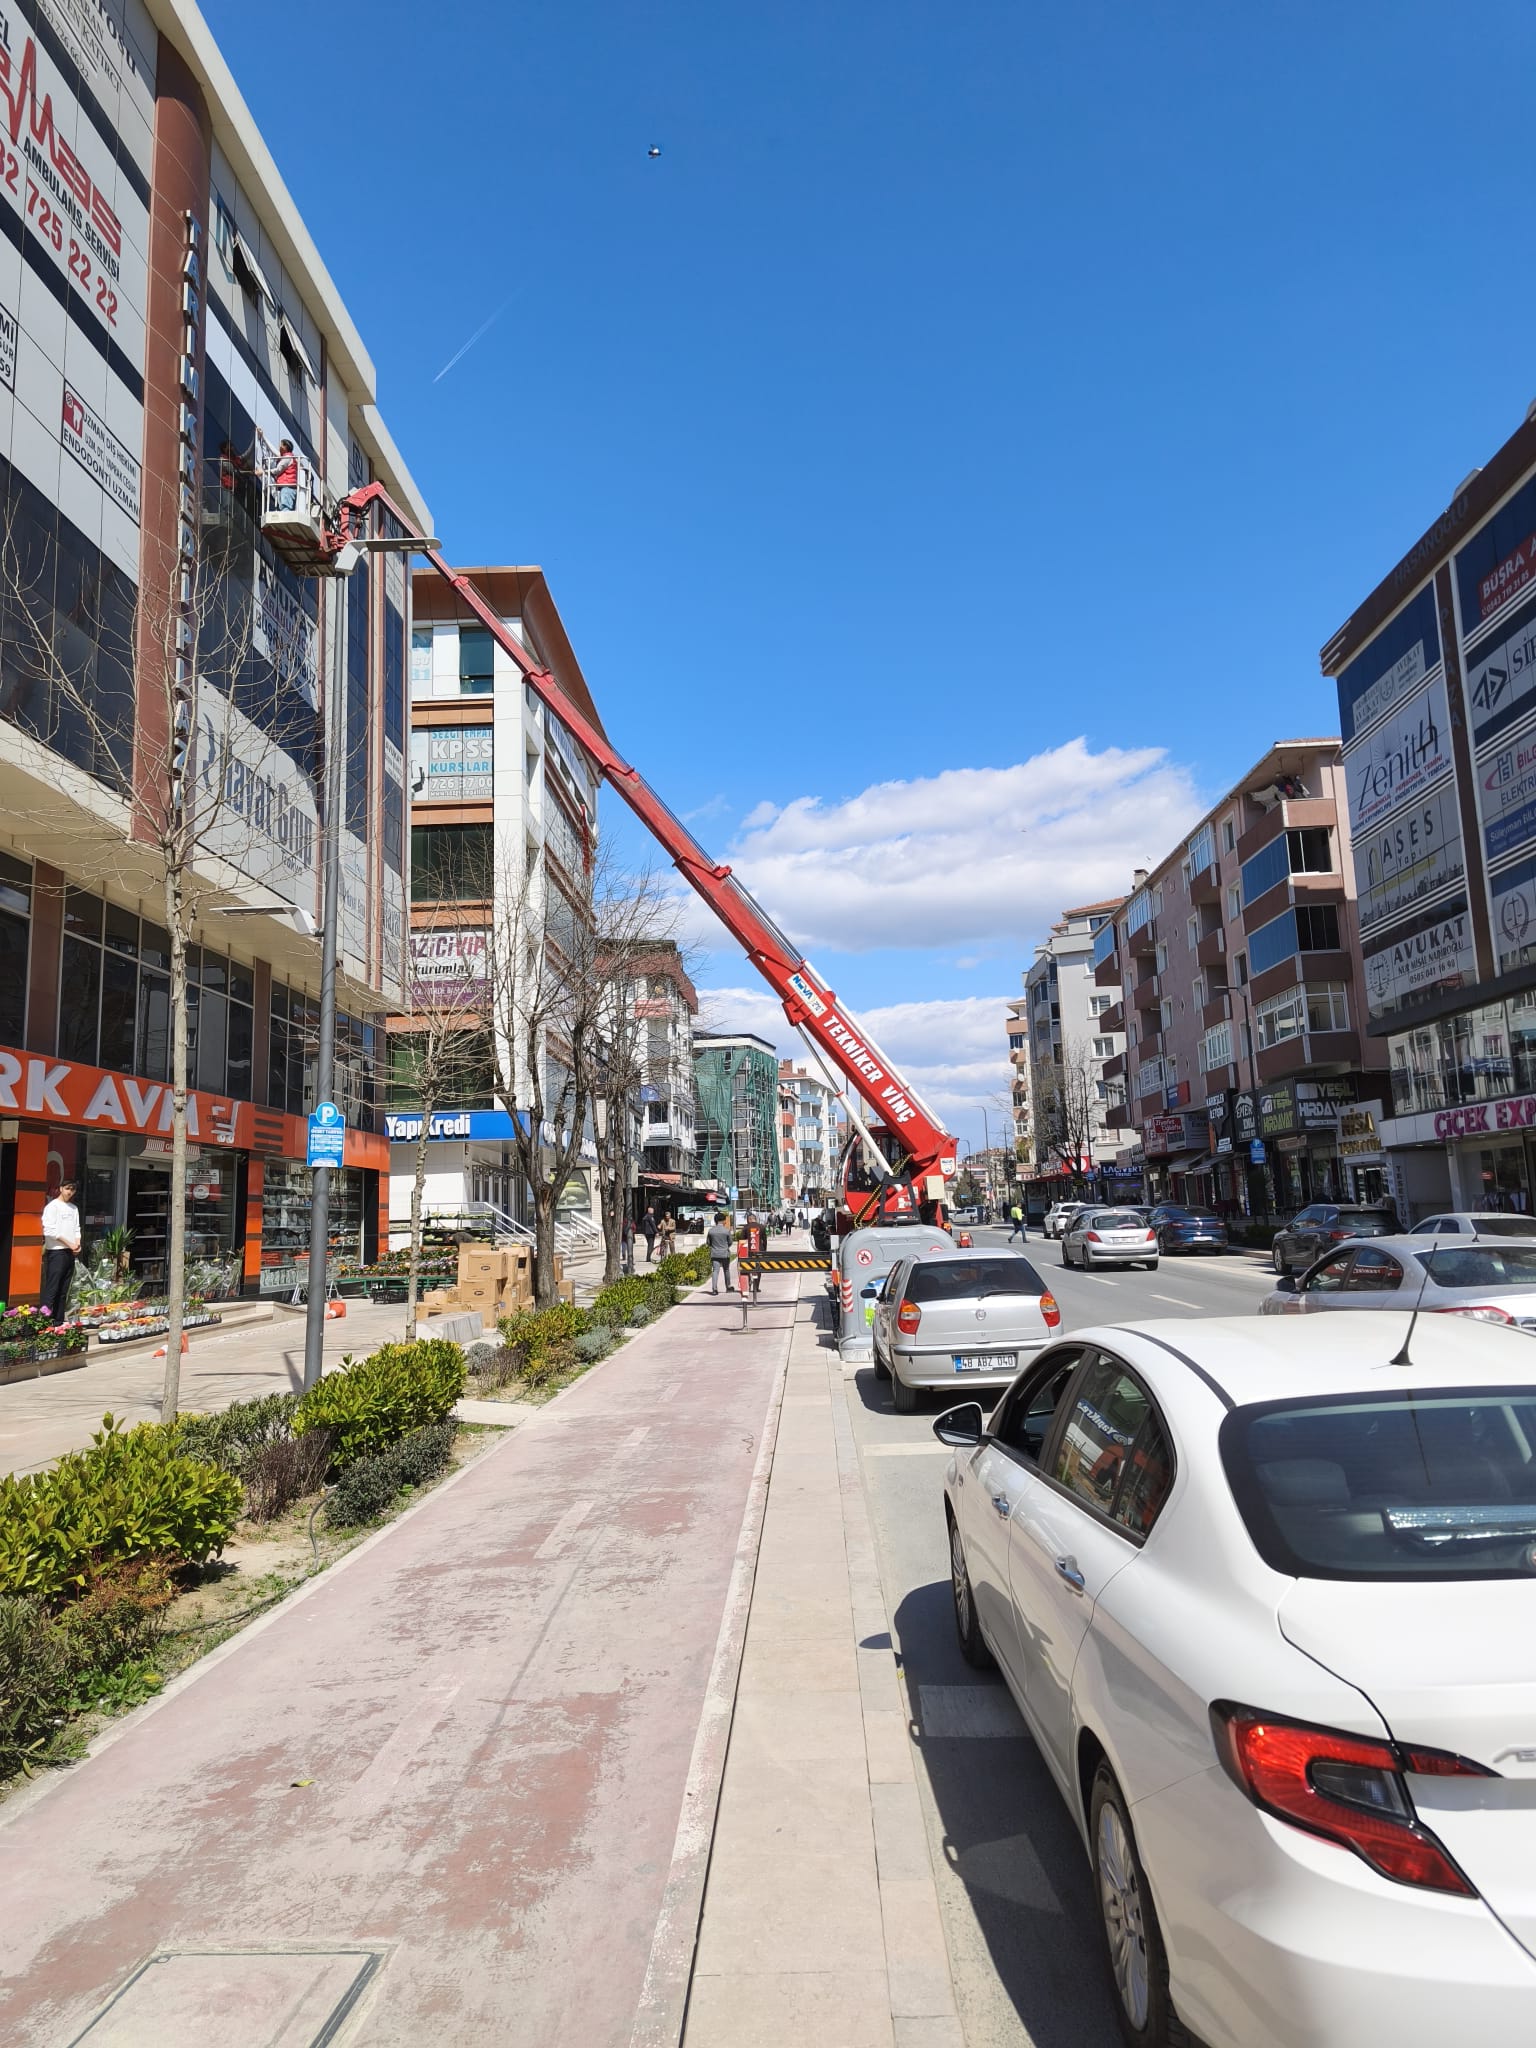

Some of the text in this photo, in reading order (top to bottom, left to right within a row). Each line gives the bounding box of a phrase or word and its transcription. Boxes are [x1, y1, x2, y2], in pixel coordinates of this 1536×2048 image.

[24, 136, 120, 284] AMBULANS SERVİSİ
[26, 175, 63, 252] 725
[67, 237, 91, 293] 22
[95, 274, 117, 328] 22
[180, 208, 200, 401] TARIM
[63, 427, 112, 491] ENDODONTİ
[1482, 552, 1525, 600] BÜŞRA
[431, 739, 493, 759] KPSS
[431, 778, 454, 789] 726
[1383, 810, 1434, 863] ASES
[1394, 916, 1465, 966] AVUKAT
[823, 1015, 916, 1123] TEKNİKER VİNÇ
[84, 1074, 200, 1137] AVM
[322, 1106, 335, 1124] P
[1299, 1099, 1356, 1118] HIRDAV
[1434, 1105, 1490, 1144] ÇİÇEK
[962, 1355, 1014, 1369] 48 ABZ 040
